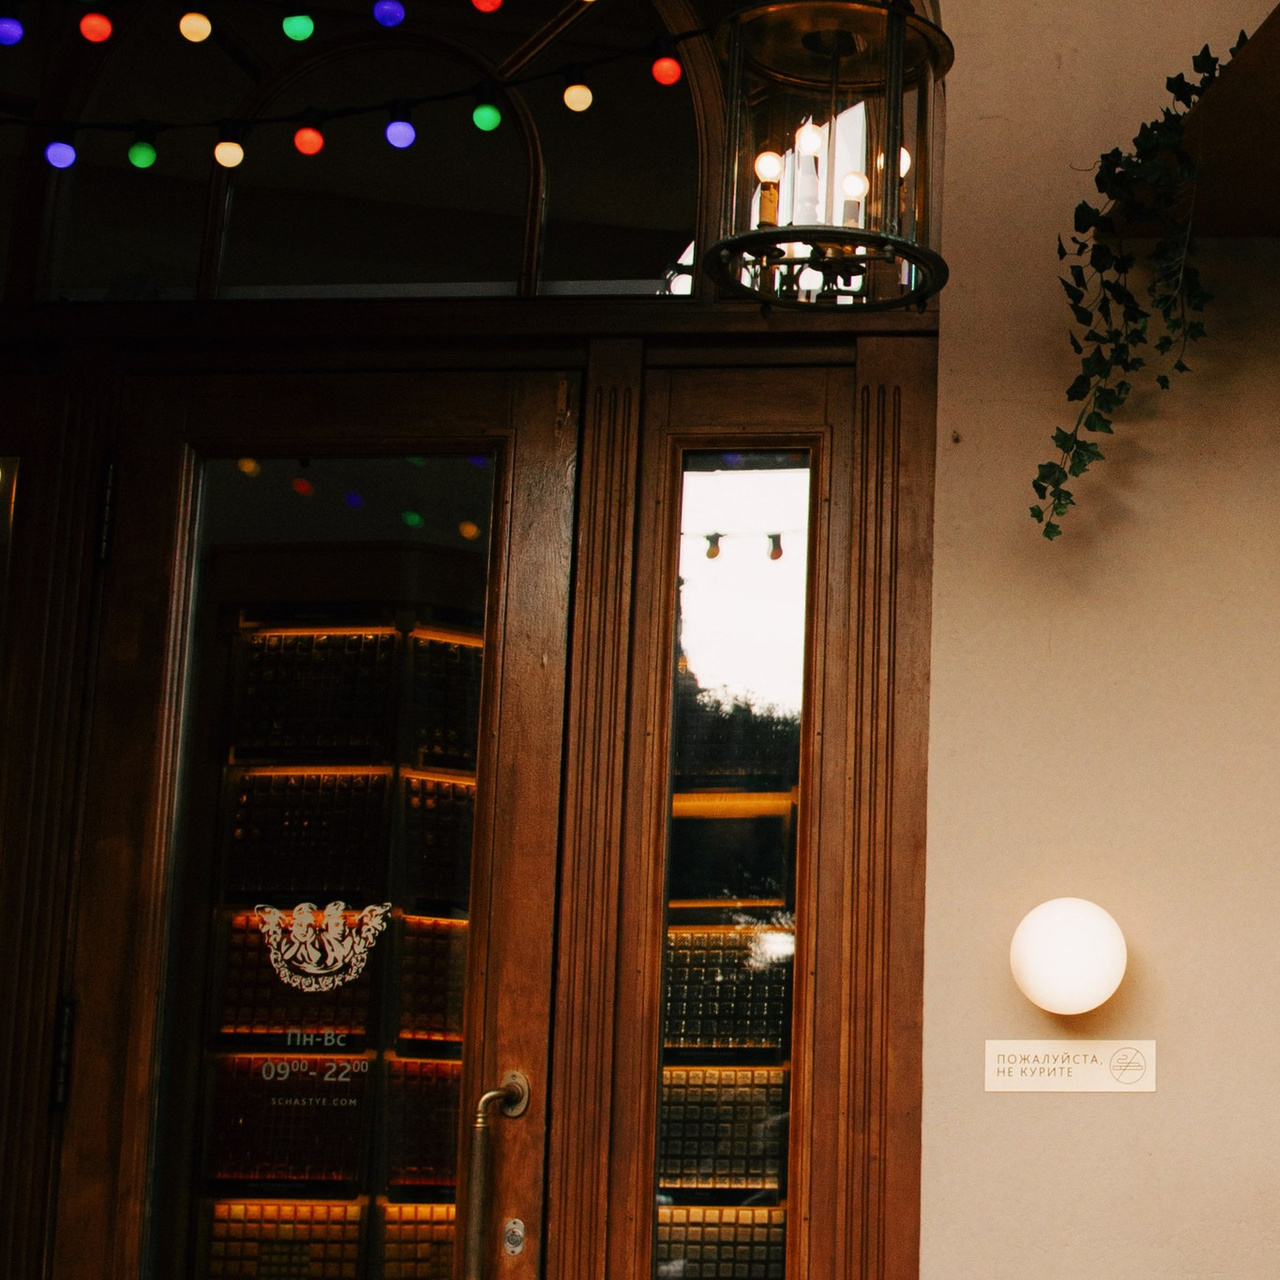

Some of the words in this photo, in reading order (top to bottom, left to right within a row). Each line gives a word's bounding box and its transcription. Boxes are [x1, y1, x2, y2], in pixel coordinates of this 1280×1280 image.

[287, 1029, 347, 1047] Пн-Вс
[996, 1052, 1103, 1066] ПОЖАЛУЙСТА,
[996, 1067, 1013, 1077] НЕ
[1020, 1067, 1073, 1077] КУРИТЕ
[271, 1097, 357, 1106] SCHASTYE.COM
